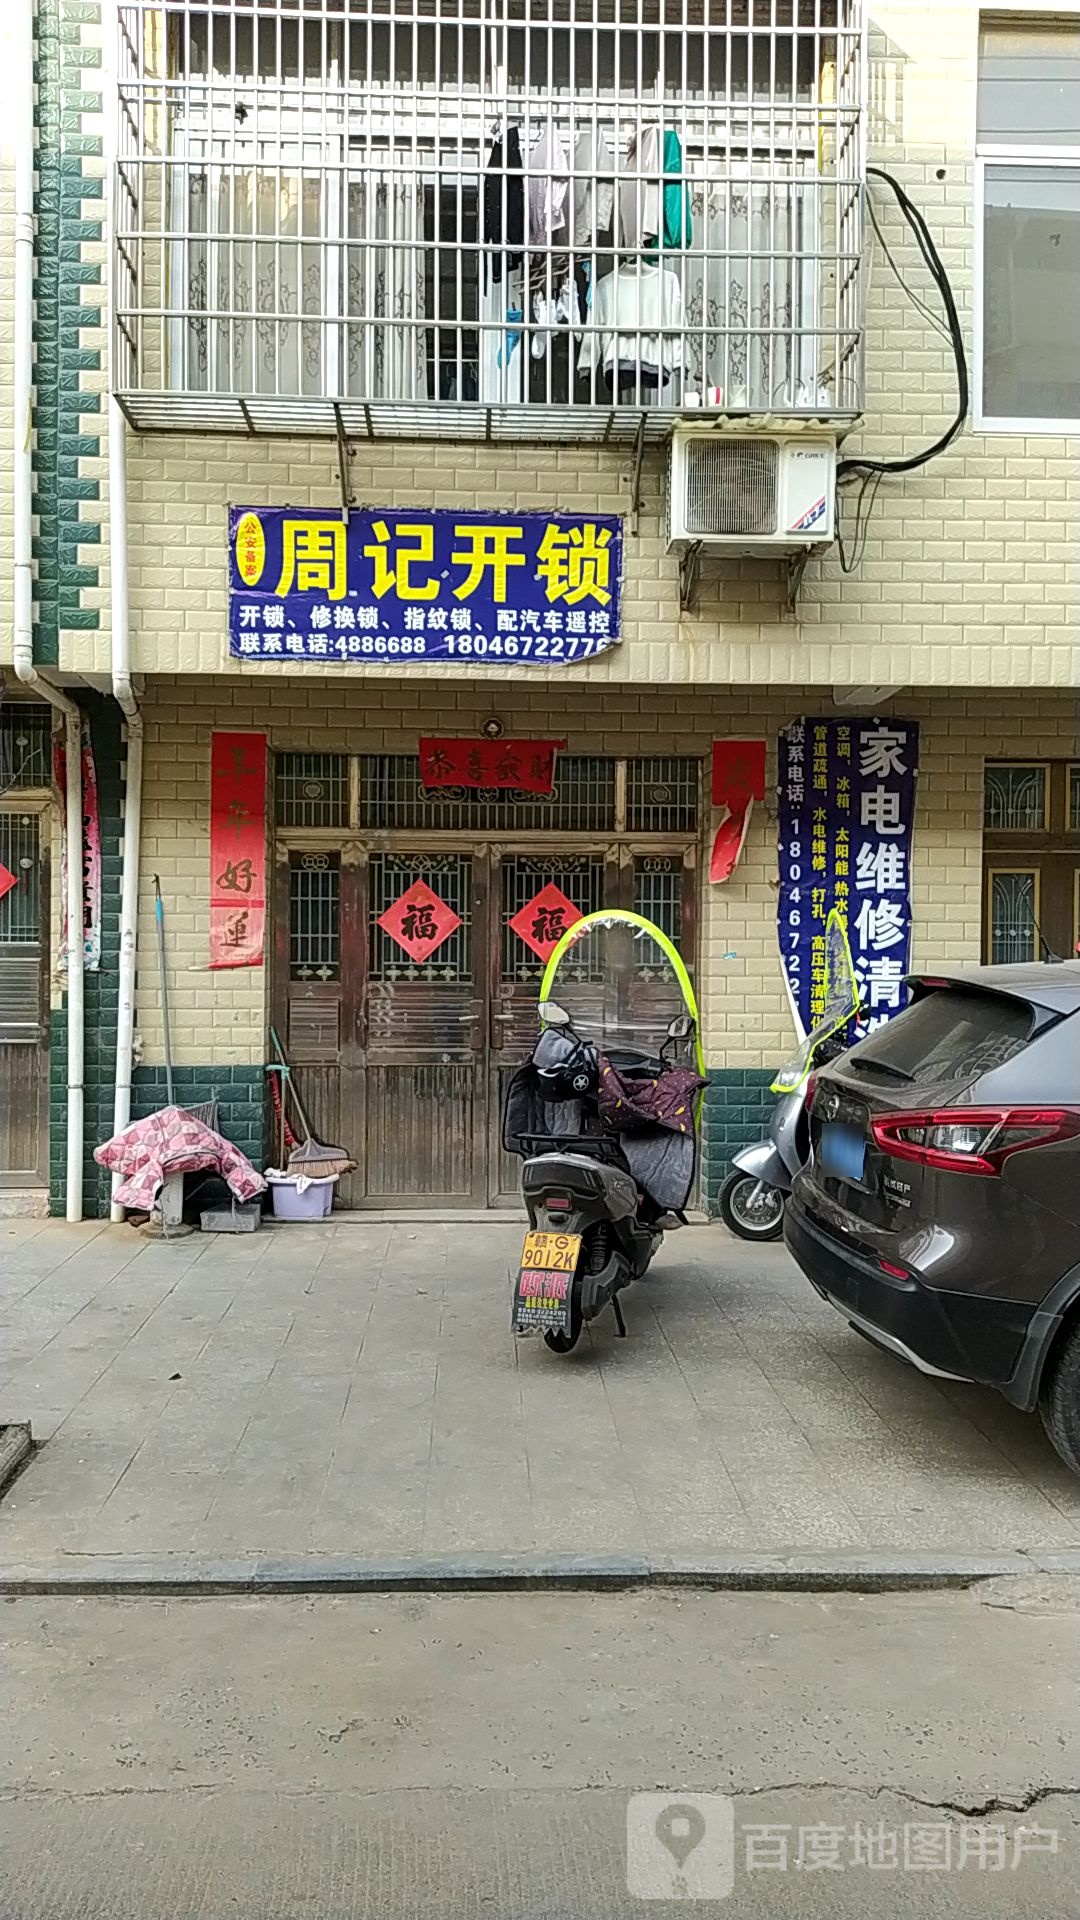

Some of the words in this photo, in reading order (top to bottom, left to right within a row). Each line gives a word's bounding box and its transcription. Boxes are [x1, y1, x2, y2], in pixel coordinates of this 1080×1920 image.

[243, 521, 257, 577] 公安备案
[274, 519, 613, 608] 周记开锁
[239, 605, 611, 634] 开锁、修换锁、指纹锁、配汽车遥控
[401, 903, 439, 941] 福
[531, 906, 567, 944] 福
[524, 1249, 575, 1269] 9012K
